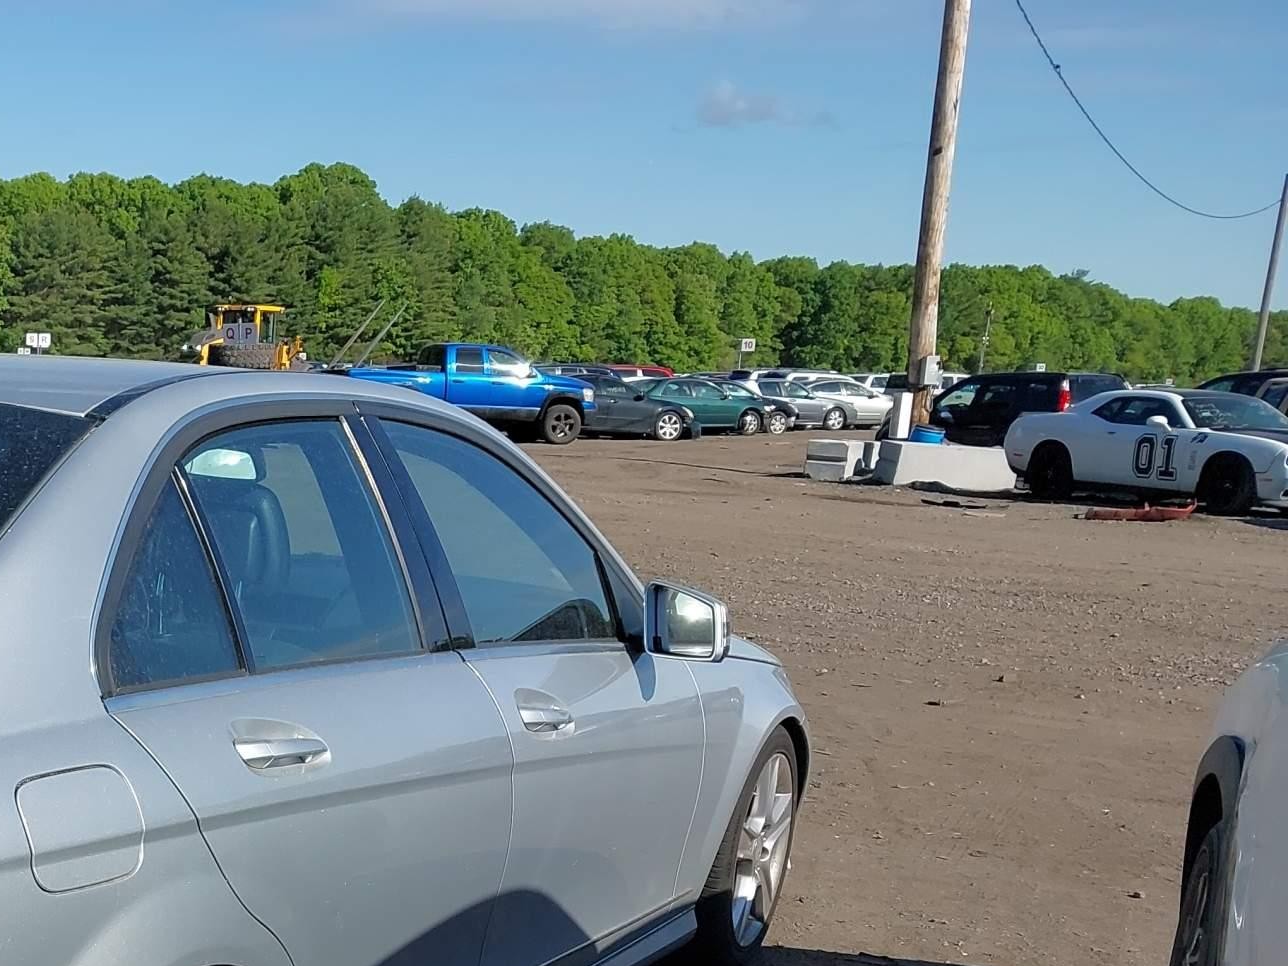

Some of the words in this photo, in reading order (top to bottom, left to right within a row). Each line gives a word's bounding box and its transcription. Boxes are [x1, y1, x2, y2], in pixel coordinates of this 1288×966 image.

[226, 328, 235, 340] Q
[245, 328, 253, 339] P
[744, 341, 753, 350] 10
[1132, 433, 1178, 481] 01
